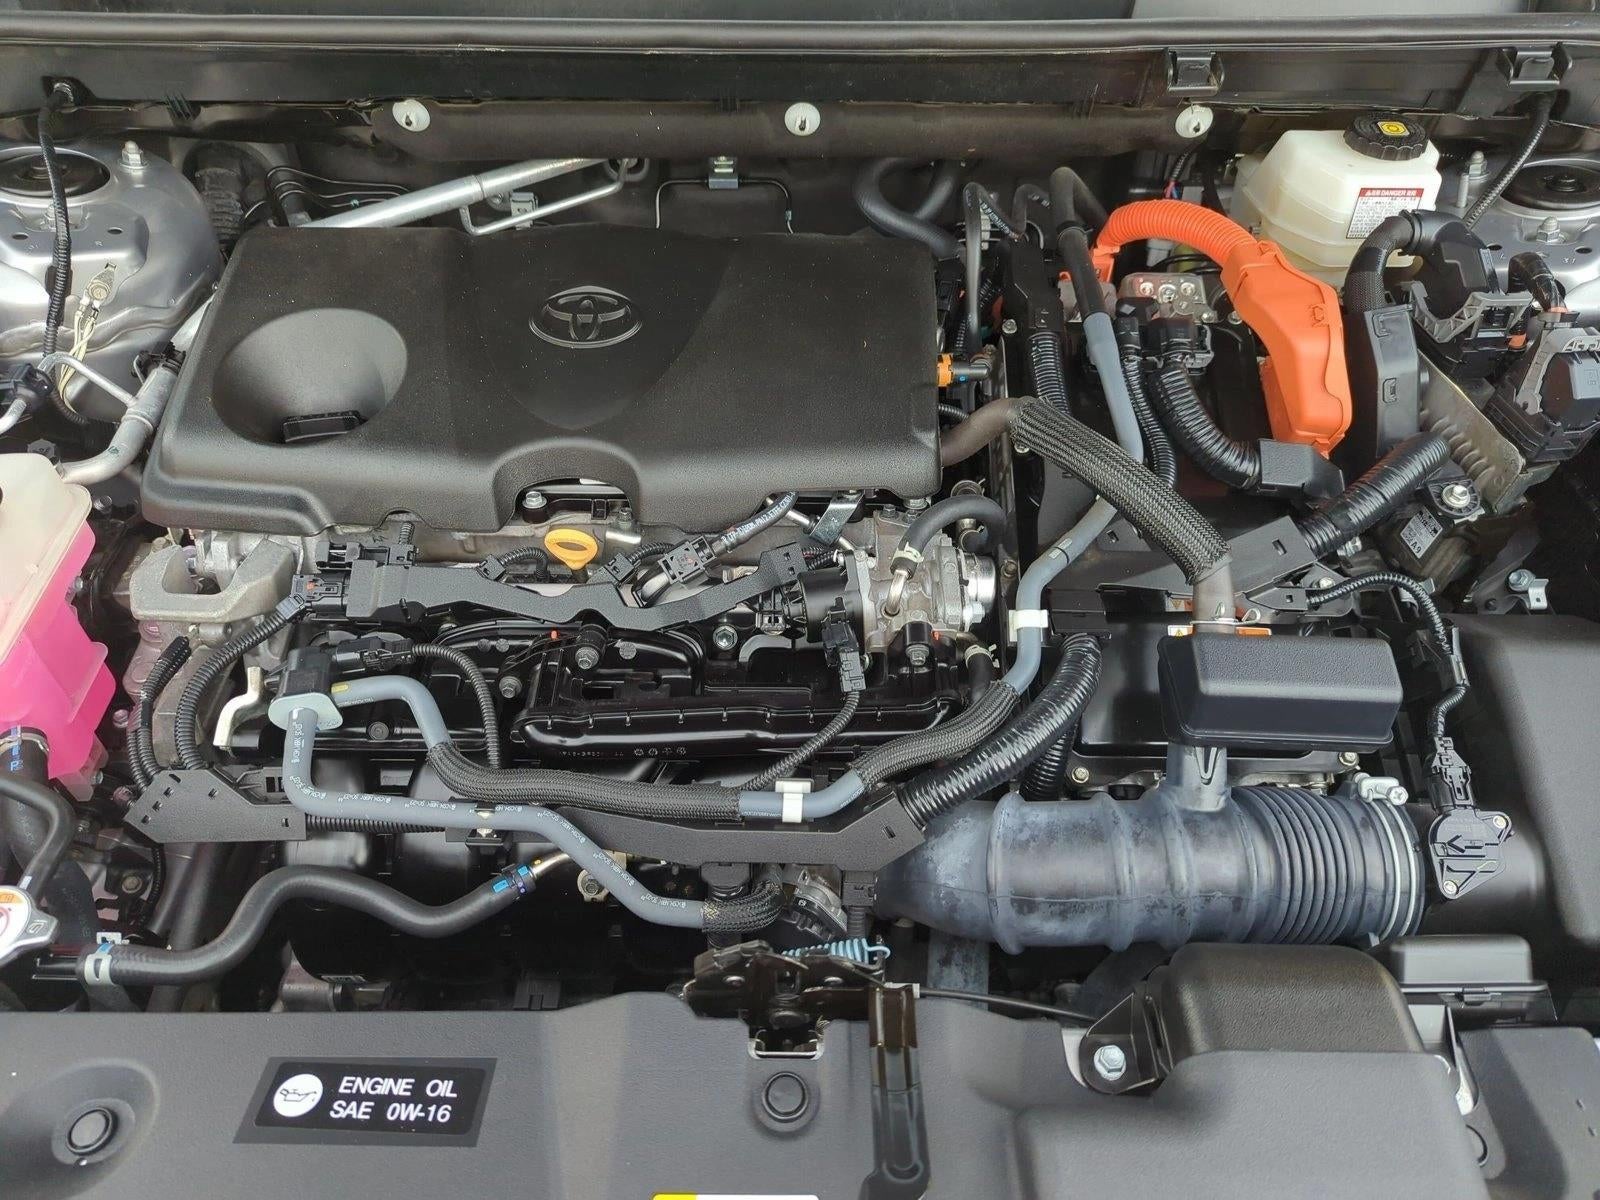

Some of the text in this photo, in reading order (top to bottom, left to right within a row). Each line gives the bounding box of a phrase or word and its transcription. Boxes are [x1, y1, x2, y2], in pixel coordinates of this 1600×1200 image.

[338, 1076, 458, 1098] ENGINE OIL
[329, 1100, 452, 1123] SAE 0W-16
